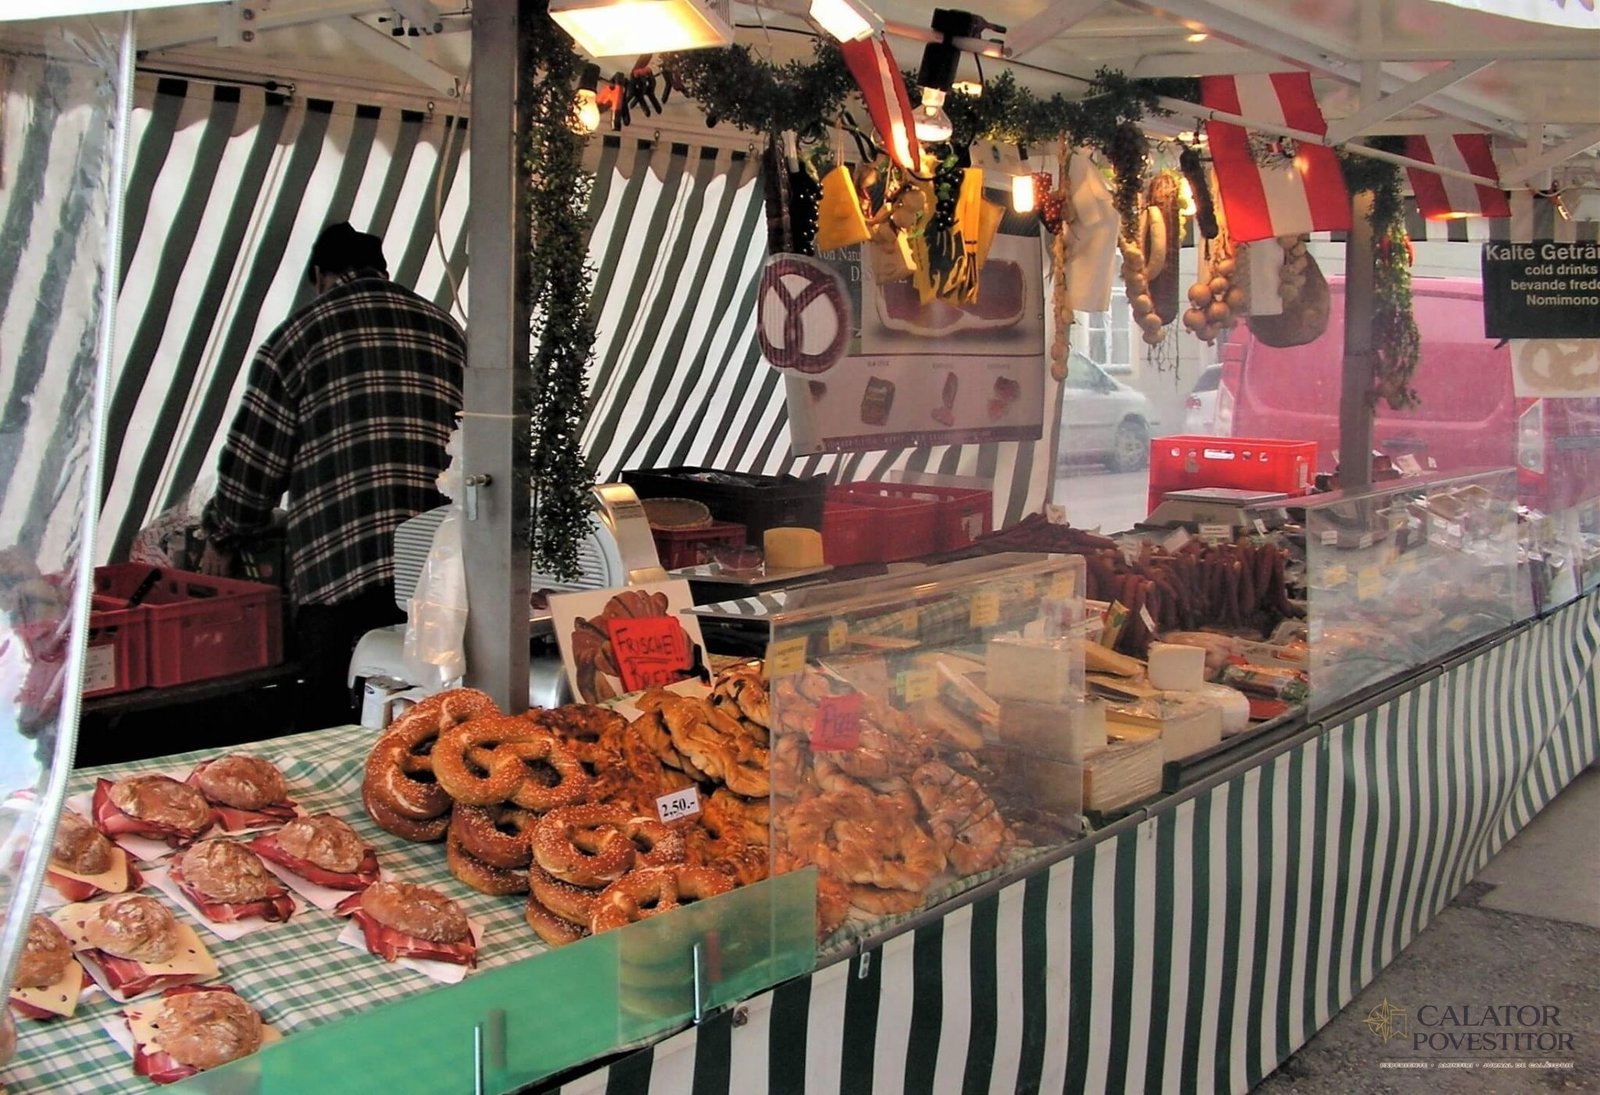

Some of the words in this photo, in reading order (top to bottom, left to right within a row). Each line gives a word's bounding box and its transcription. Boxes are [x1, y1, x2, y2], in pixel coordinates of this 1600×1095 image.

[1486, 244, 1536, 261] Kalte
[1524, 264, 1553, 276] cold
[1556, 263, 1598, 275] drinks
[1510, 280, 1567, 291] bevande
[1526, 294, 1598, 306] Nomimono
